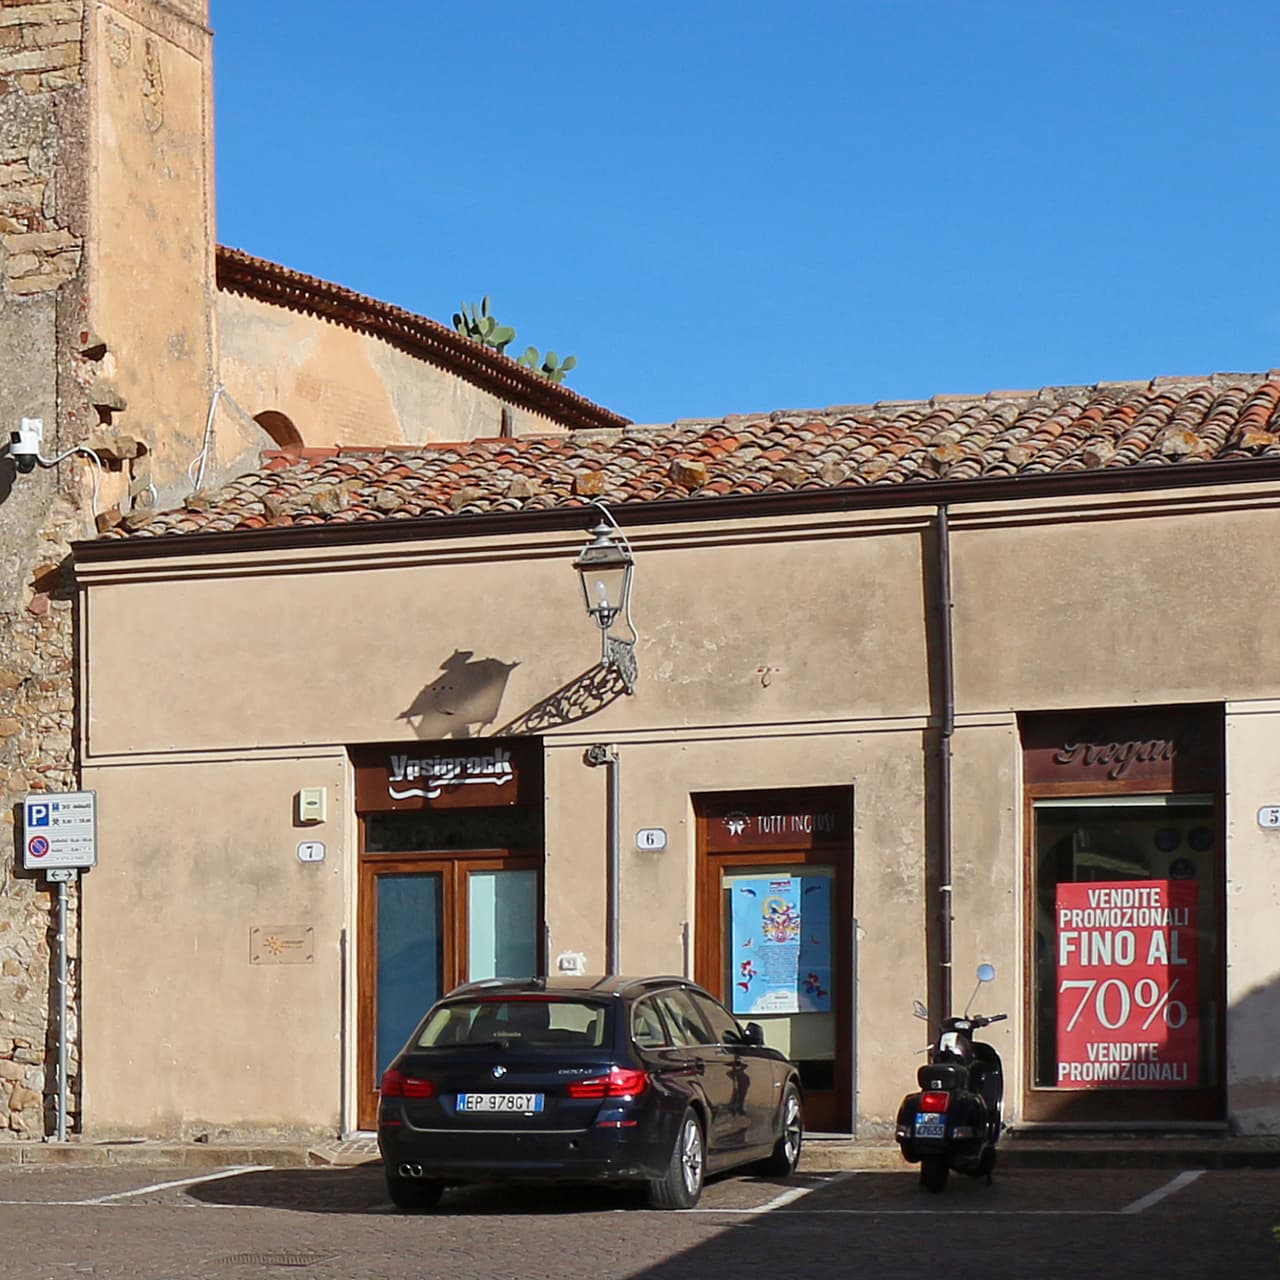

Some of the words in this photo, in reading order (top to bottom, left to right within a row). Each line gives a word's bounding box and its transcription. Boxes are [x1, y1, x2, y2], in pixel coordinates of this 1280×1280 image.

[388, 747, 513, 781] Ypsigrock
[32, 806, 47, 826] P
[758, 815, 786, 834] TUTTI
[1269, 809, 1279, 825] 5
[646, 832, 655, 846] 6
[305, 845, 314, 859] 7
[1088, 888, 1161, 908] VENDITE
[1059, 907, 1189, 928] PROMOZIONALI
[1059, 930, 1135, 966] FINO
[1147, 930, 1188, 965] AL
[1059, 978, 1188, 1032] 70%
[1086, 1043, 1159, 1061] VENDITE
[1058, 1062, 1188, 1081] PROMOZIONALI
[466, 1096, 484, 1110] EP
[489, 1096, 534, 1110] 978GY
